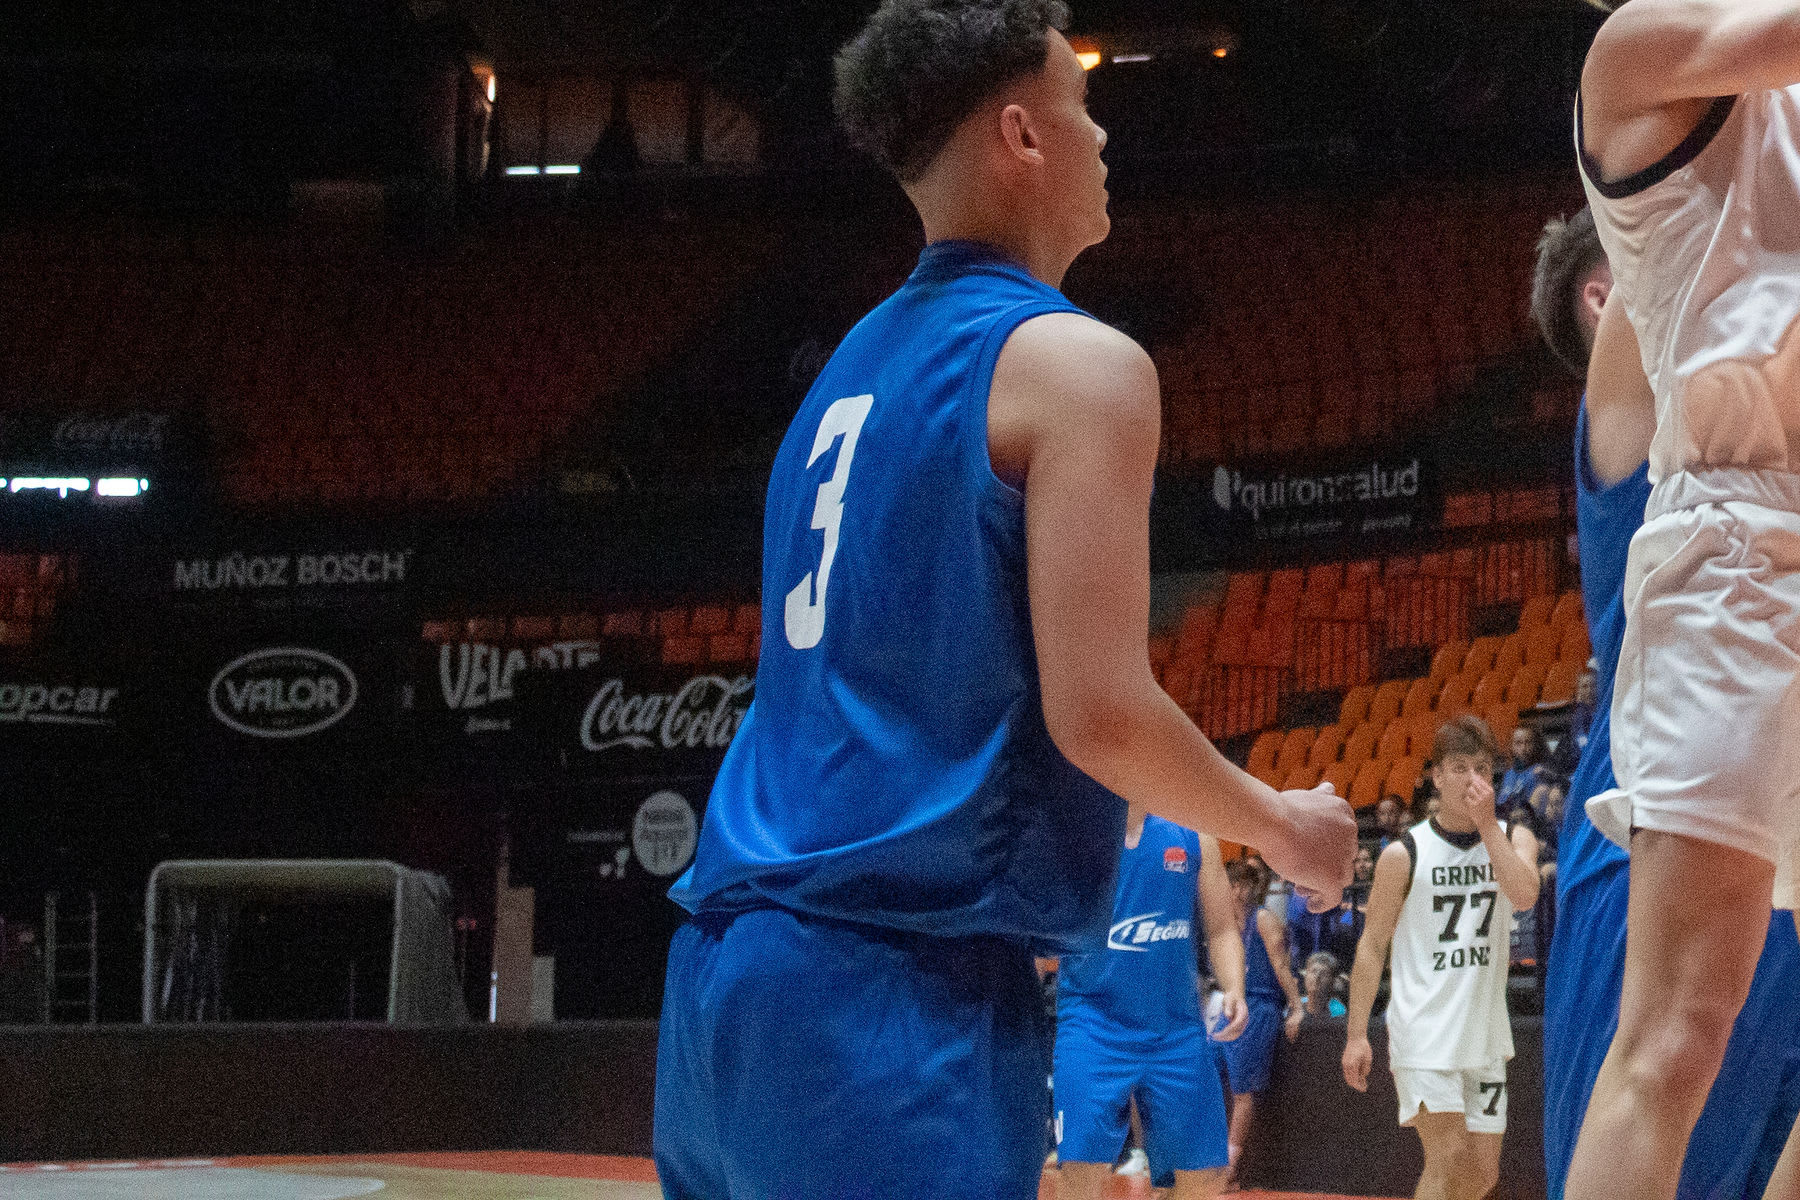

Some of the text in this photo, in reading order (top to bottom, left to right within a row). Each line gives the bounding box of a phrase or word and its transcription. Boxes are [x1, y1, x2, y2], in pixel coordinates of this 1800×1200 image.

[784, 393, 874, 650] 3
[174, 550, 405, 590] MUÑOZ BOSCH
[0, 683, 119, 721] opcar
[224, 675, 340, 713] VALOR
[580, 673, 755, 751] Coca-Cola
[1433, 890, 1498, 943] 77
[1480, 1081, 1507, 1116] 7
